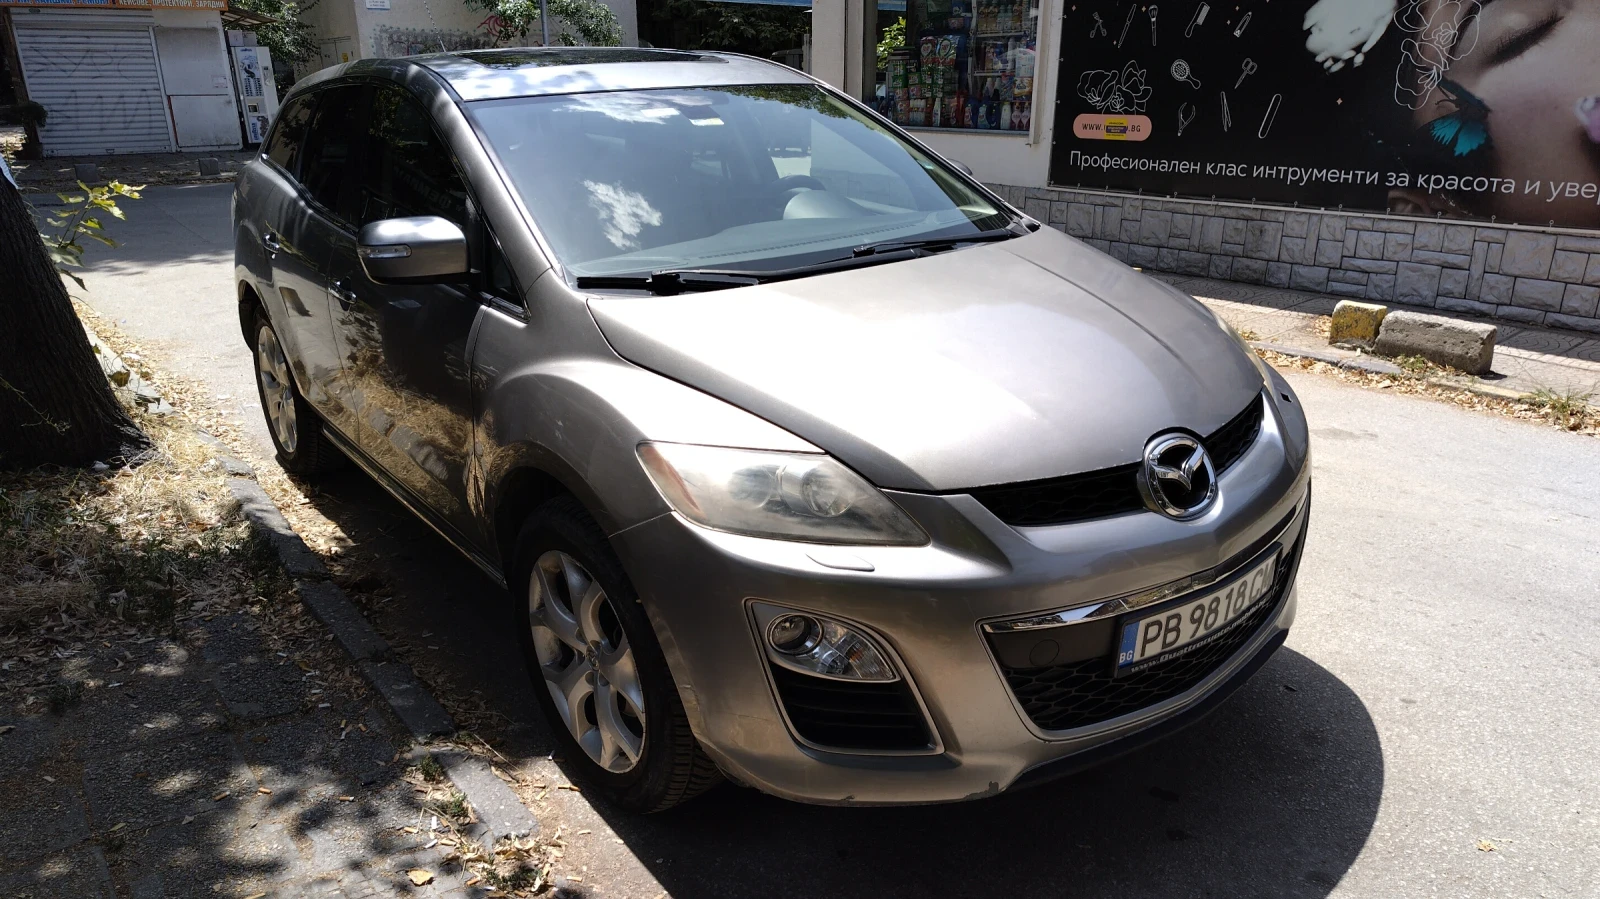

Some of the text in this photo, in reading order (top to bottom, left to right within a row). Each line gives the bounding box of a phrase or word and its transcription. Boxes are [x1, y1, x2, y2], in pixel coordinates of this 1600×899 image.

[1070, 150, 1200, 174] Професионален
[1206, 162, 1247, 177] клас
[1252, 164, 1378, 186] интрументи
[1385, 171, 1409, 187] за
[1417, 173, 1516, 194] красота
[1524, 180, 1541, 195] и
[1140, 613, 1182, 658] PB
[1190, 579, 1247, 640] 9818
[1119, 650, 1133, 664] BG
